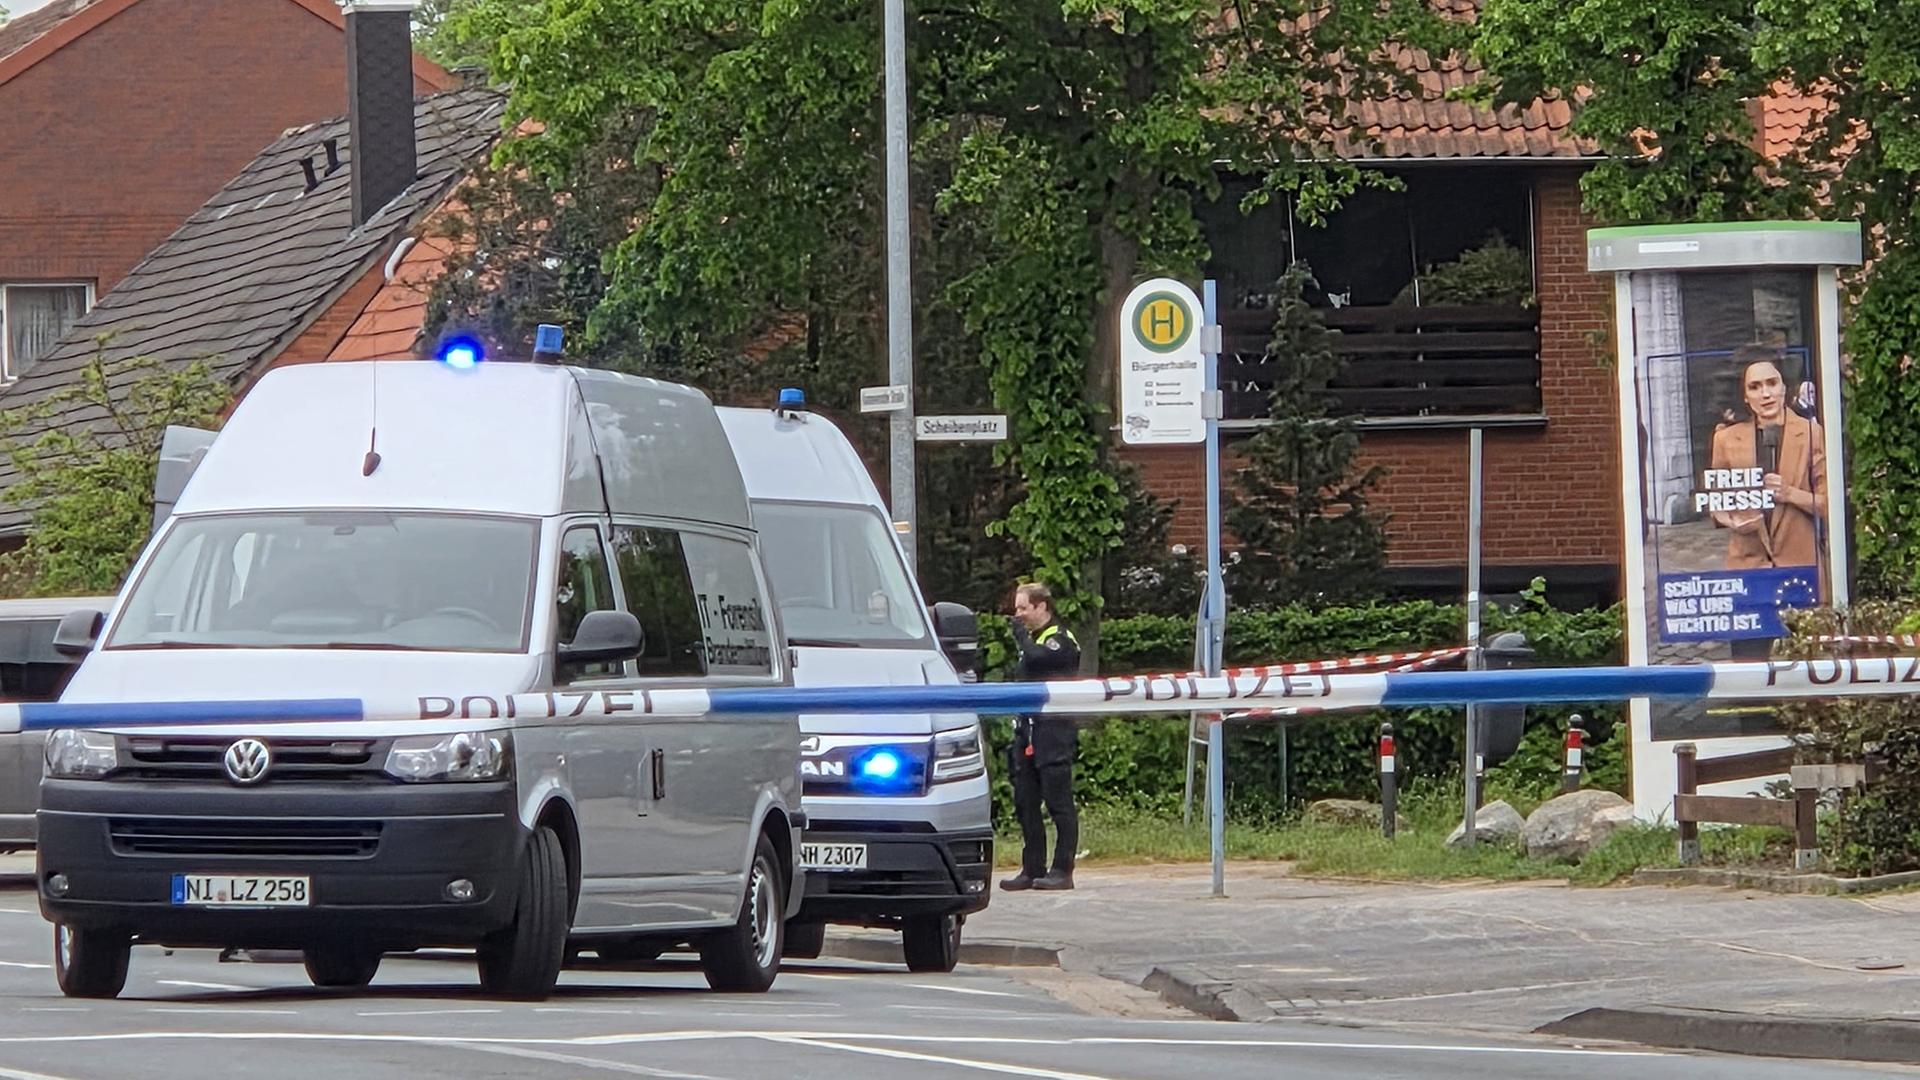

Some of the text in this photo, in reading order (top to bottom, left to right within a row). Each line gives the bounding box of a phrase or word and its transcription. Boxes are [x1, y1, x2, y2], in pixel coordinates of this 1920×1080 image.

[1150, 304, 1175, 339] H
[923, 420, 998, 435] Scheibenplatz
[1704, 467, 1764, 490] FREIE
[1695, 489, 1775, 513] PRESSE
[1664, 576, 1748, 599] SCHÜTZEN,
[1665, 596, 1734, 616] WAS UNS
[1665, 613, 1762, 635] WICHTIG IST.
[1102, 674, 1332, 701] POLIZEI
[800, 761, 844, 776] AN
[823, 846, 864, 865] 2307
[186, 878, 306, 901] NI LZ 258
